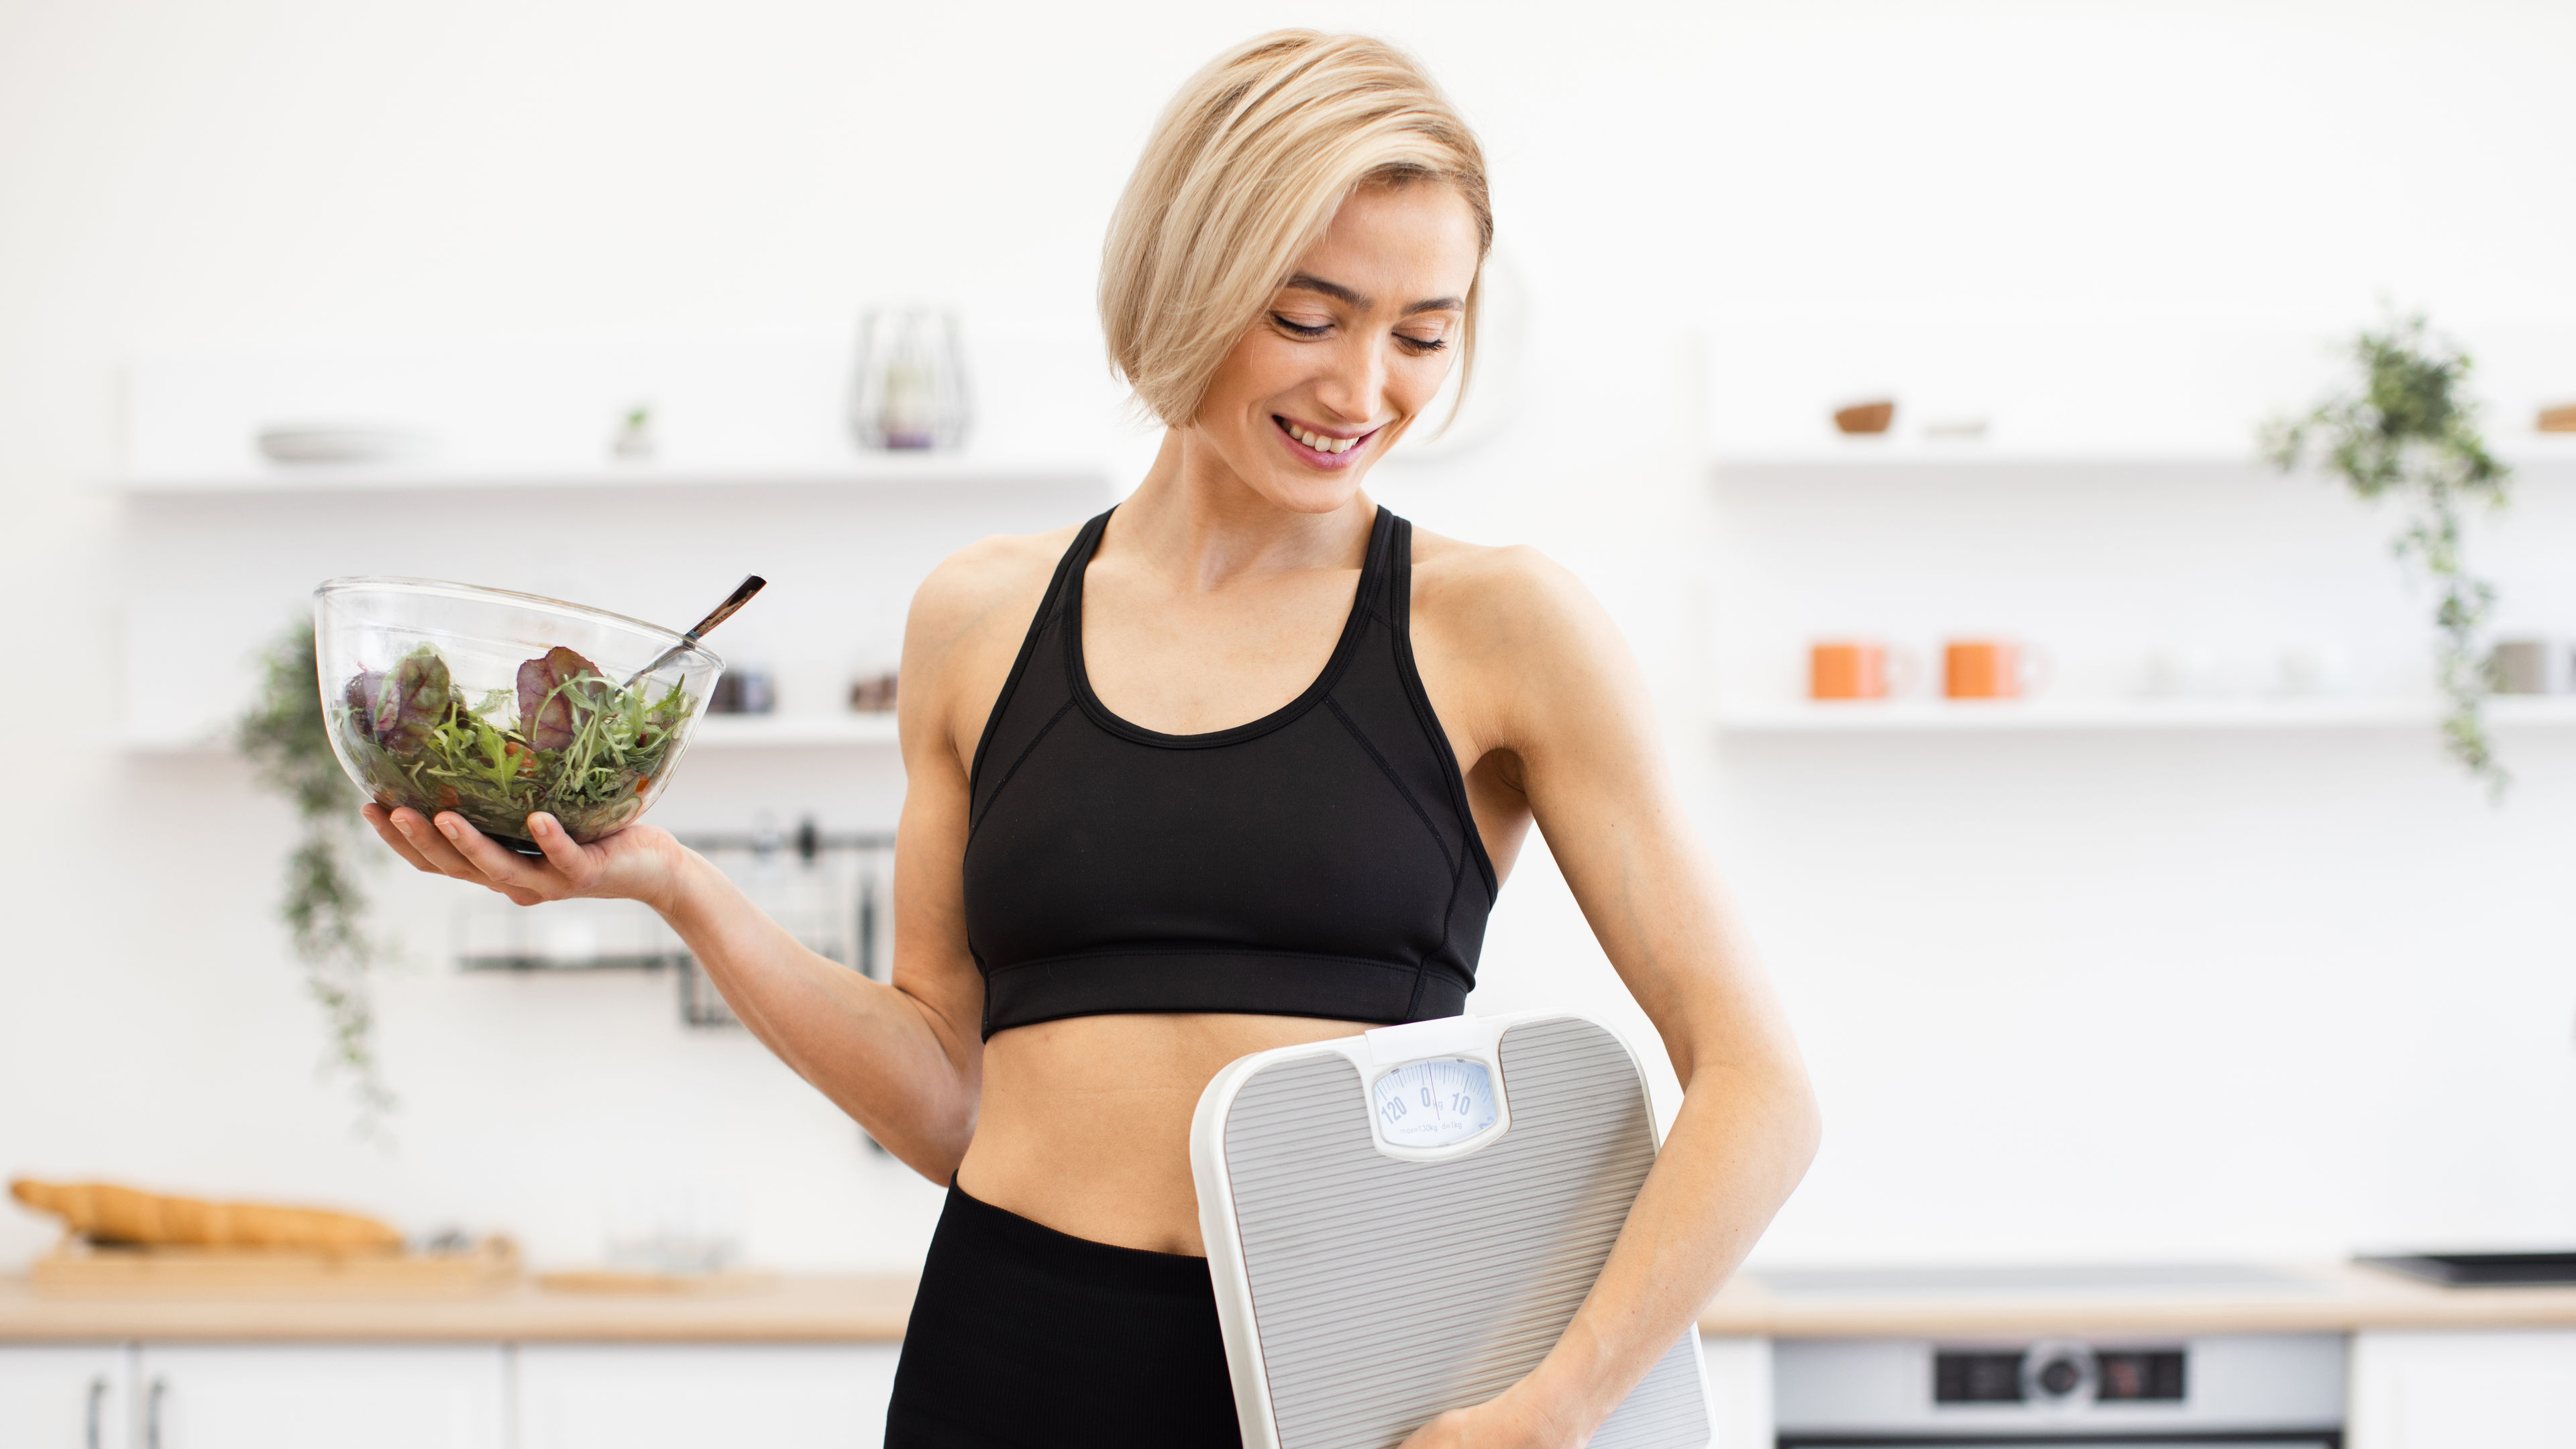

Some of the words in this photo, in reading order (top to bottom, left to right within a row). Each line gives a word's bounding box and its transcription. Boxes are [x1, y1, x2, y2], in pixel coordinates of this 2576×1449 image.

[1420, 1087, 1431, 1108] 0
[1452, 1092, 1471, 1116] 10
[1381, 1096, 1407, 1124] 120
[1400, 1124, 1438, 1134] max=130kg
